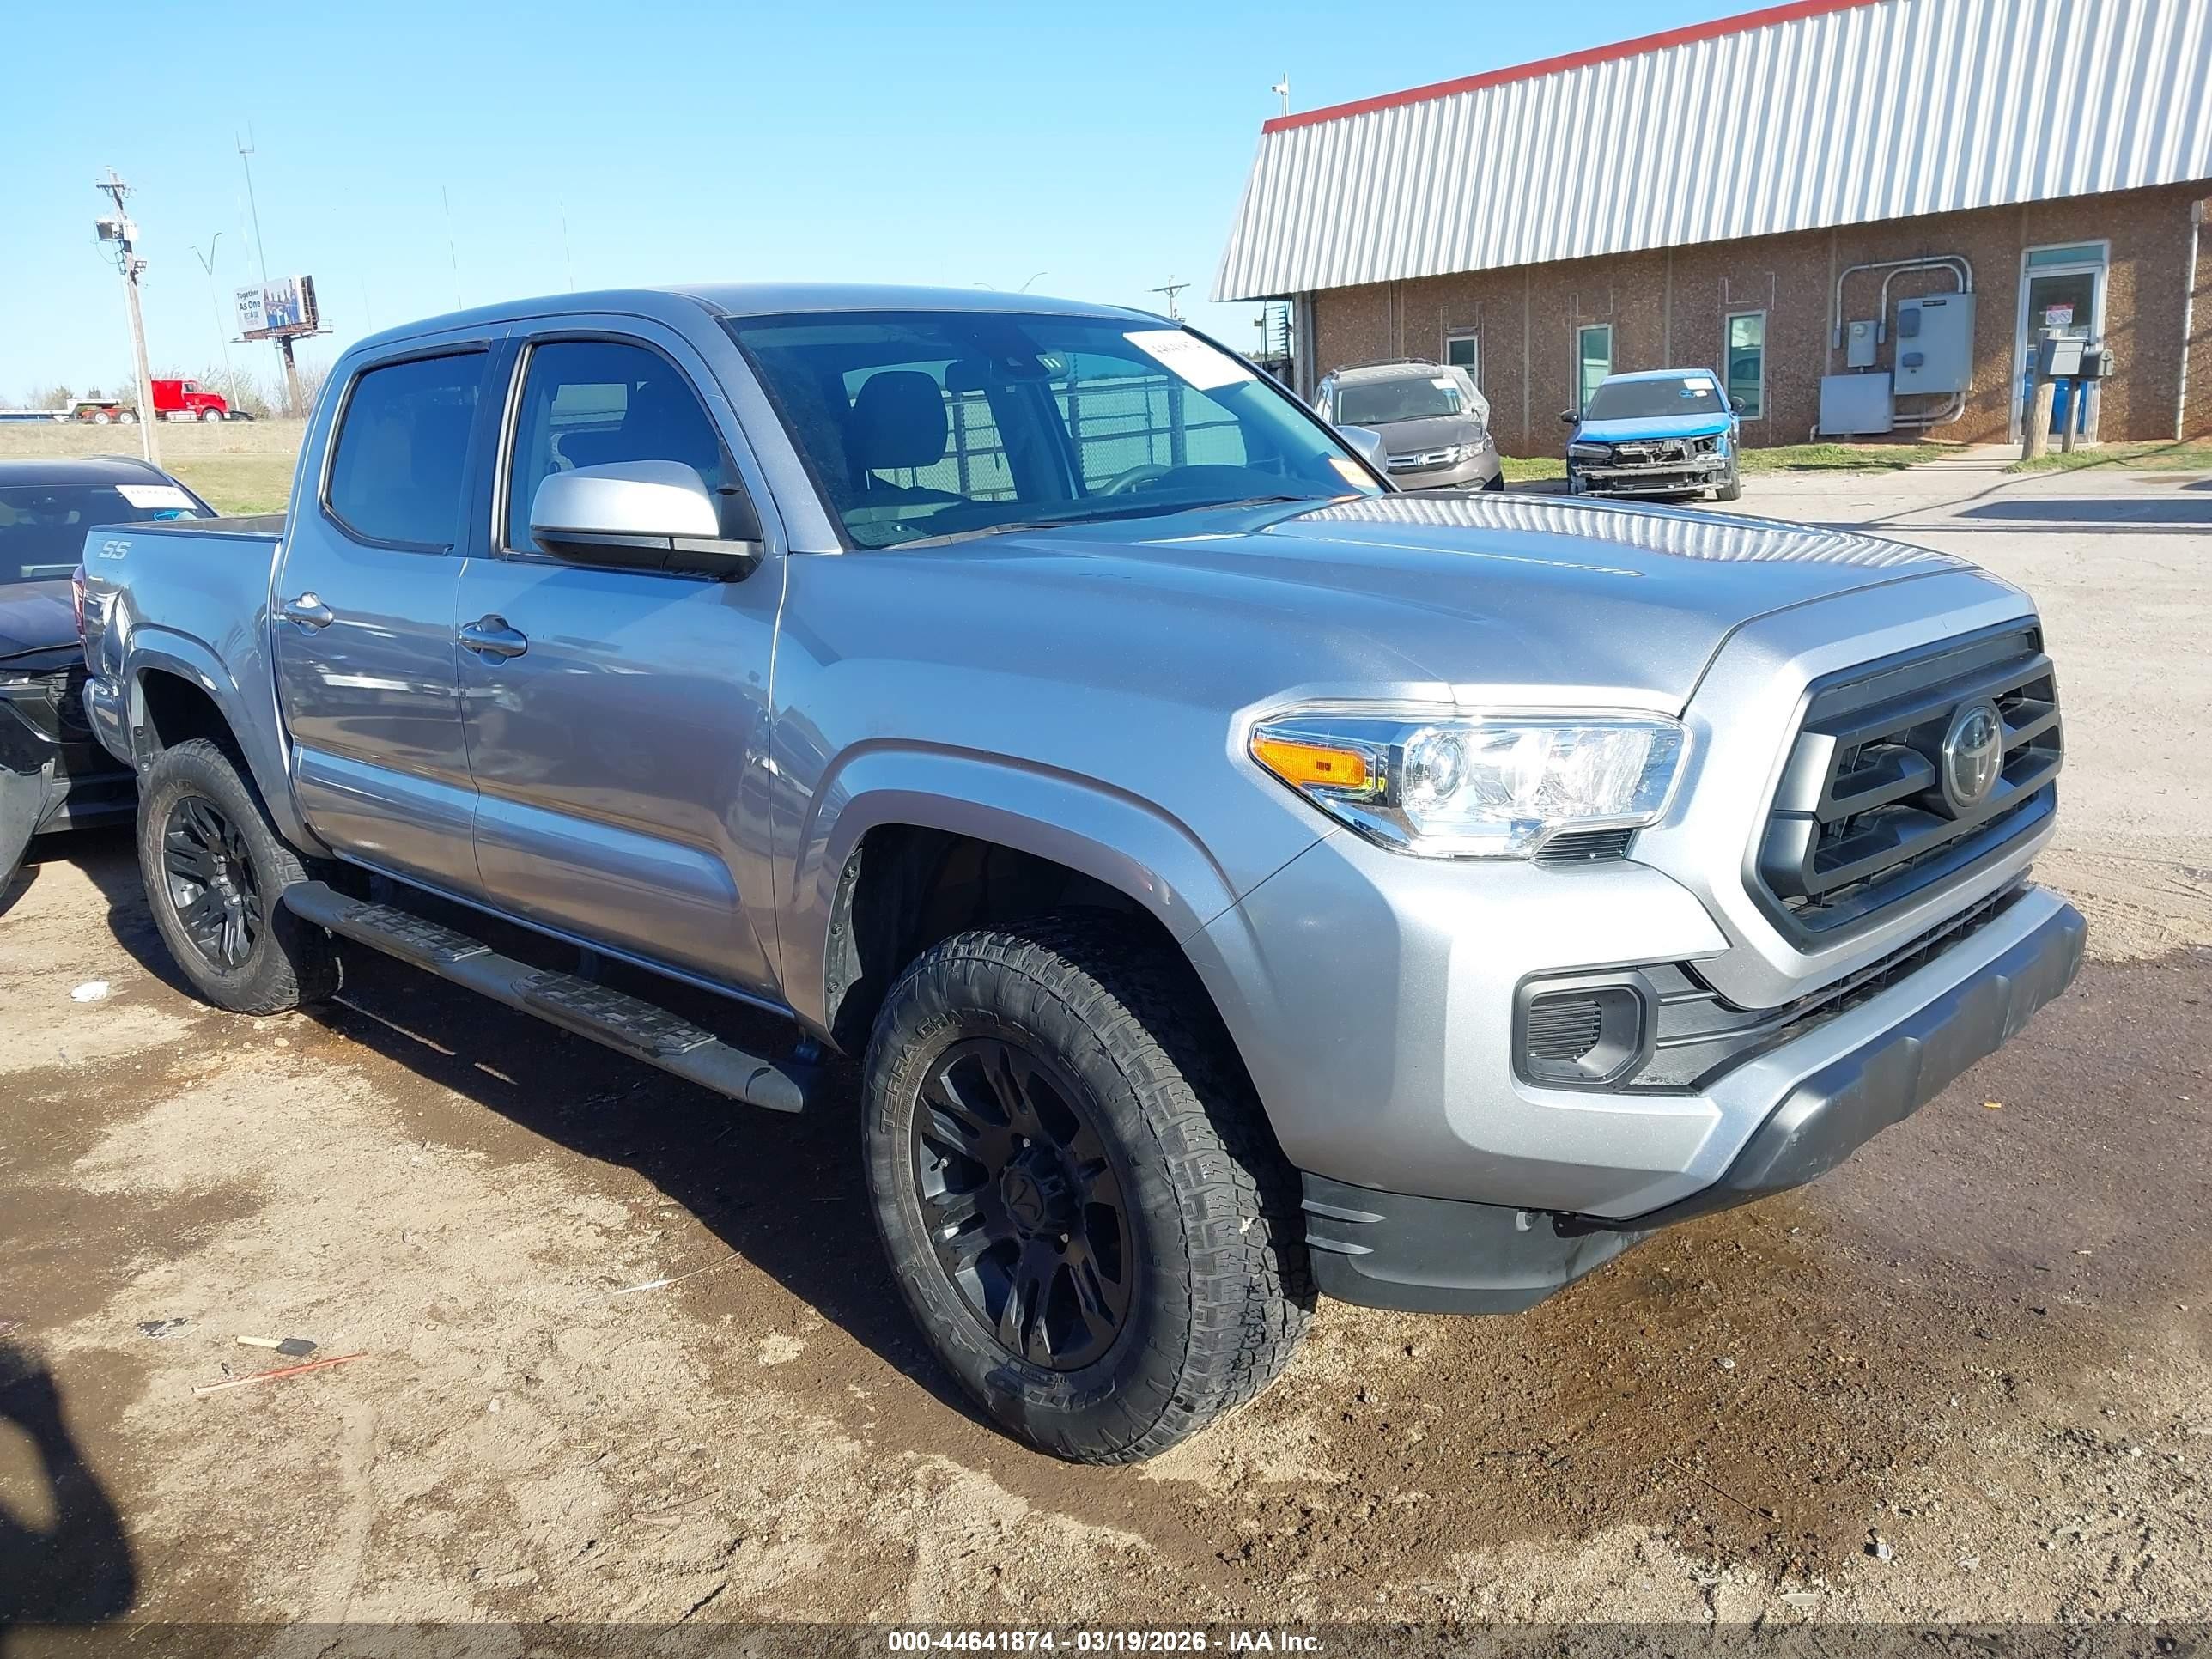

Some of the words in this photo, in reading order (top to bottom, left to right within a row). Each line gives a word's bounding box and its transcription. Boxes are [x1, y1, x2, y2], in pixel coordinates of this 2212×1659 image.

[236, 289, 259, 301] Together
[239, 302, 248, 312] As
[248, 300, 261, 311] One
[880, 1043, 921, 1133] TERRA
